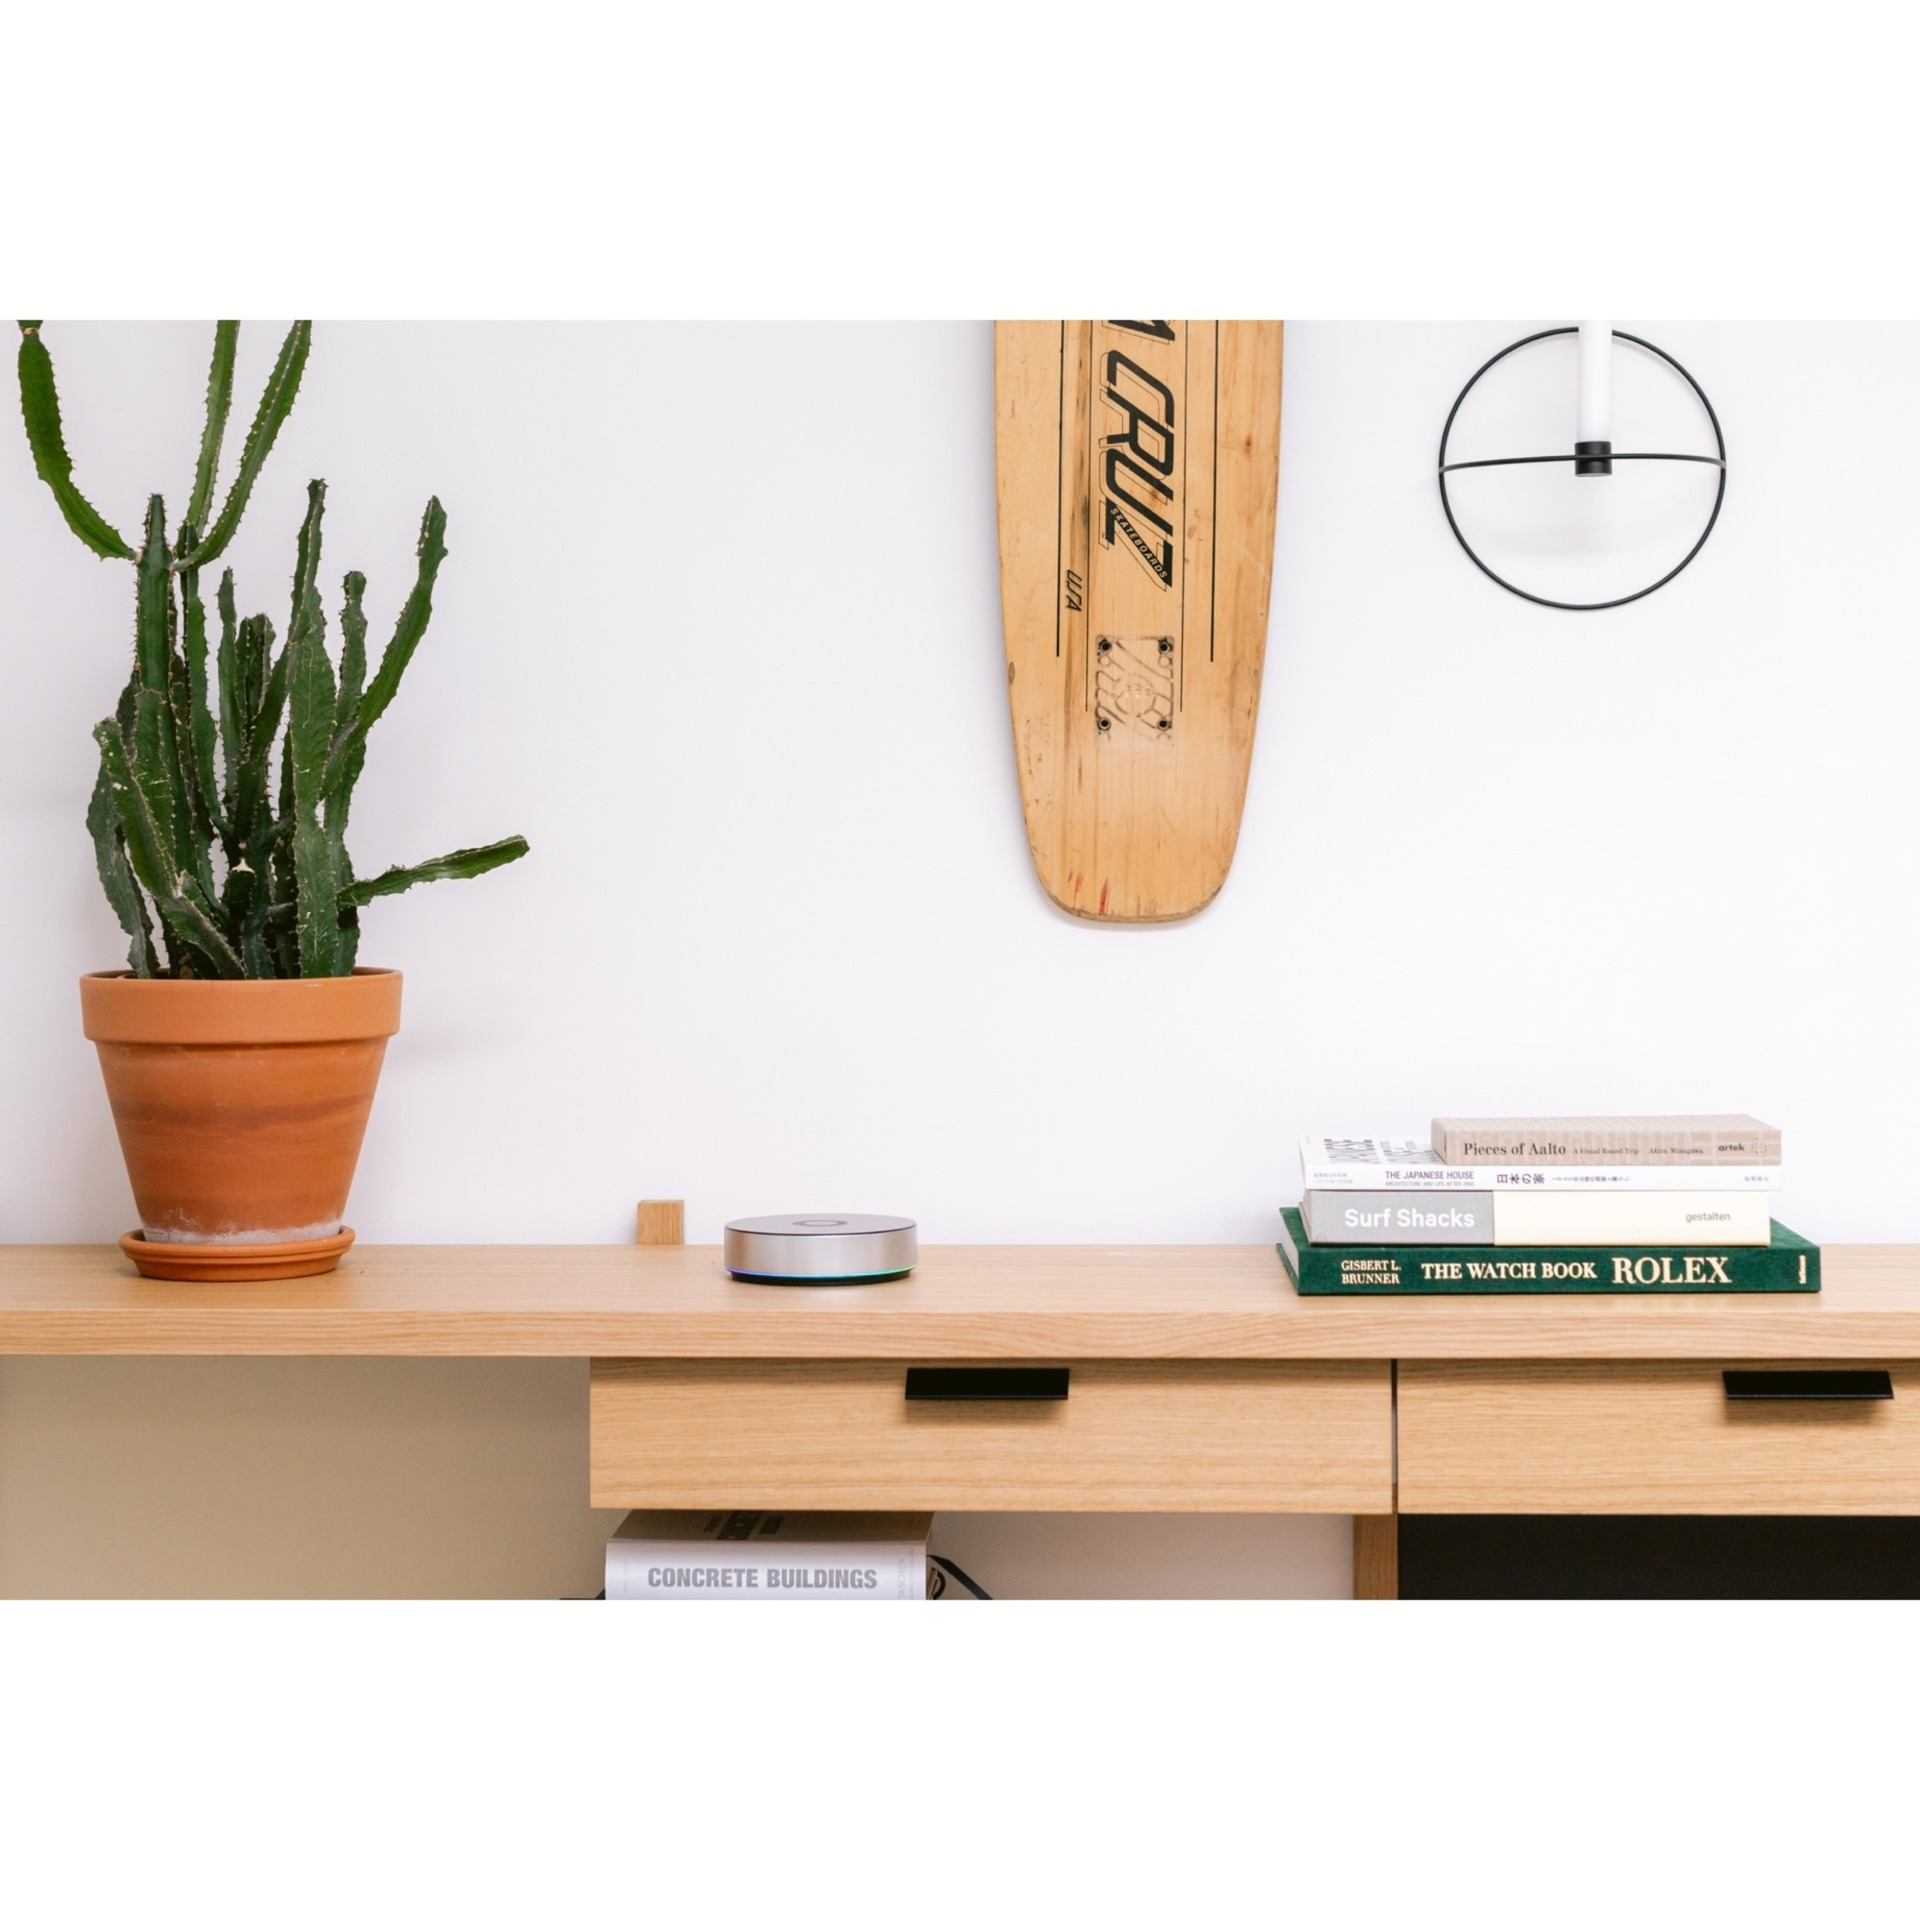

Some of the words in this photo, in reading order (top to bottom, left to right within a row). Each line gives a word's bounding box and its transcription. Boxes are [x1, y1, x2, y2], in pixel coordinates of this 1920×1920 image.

[1100, 350, 1175, 588] CRUZ
[1110, 507, 1168, 578] SKATEBOARDS
[1065, 569, 1083, 612] USA
[1463, 1142, 1507, 1156] Pieces
[1511, 1142, 1526, 1156] of
[1528, 1142, 1567, 1156] Aalto
[1718, 1142, 1745, 1152] artek
[1385, 1170, 1401, 1180] THE
[1403, 1170, 1445, 1180] JAPANESE
[1447, 1170, 1474, 1180] HOUSE
[1344, 1207, 1391, 1228] Surf
[1397, 1207, 1475, 1228] Shacks
[1685, 1211, 1731, 1223] gestalten
[1341, 1260, 1389, 1271] GISBERT
[1390, 1260, 1401, 1271] L.
[1421, 1263, 1463, 1279] THE
[1466, 1262, 1537, 1279] WATCH
[1541, 1262, 1598, 1279] BOOK
[1611, 1256, 1732, 1284] ROLEX
[1341, 1273, 1401, 1284] BRUNNER
[648, 1567, 758, 1588] CONCRETE
[767, 1568, 878, 1589] BUILDINGS
